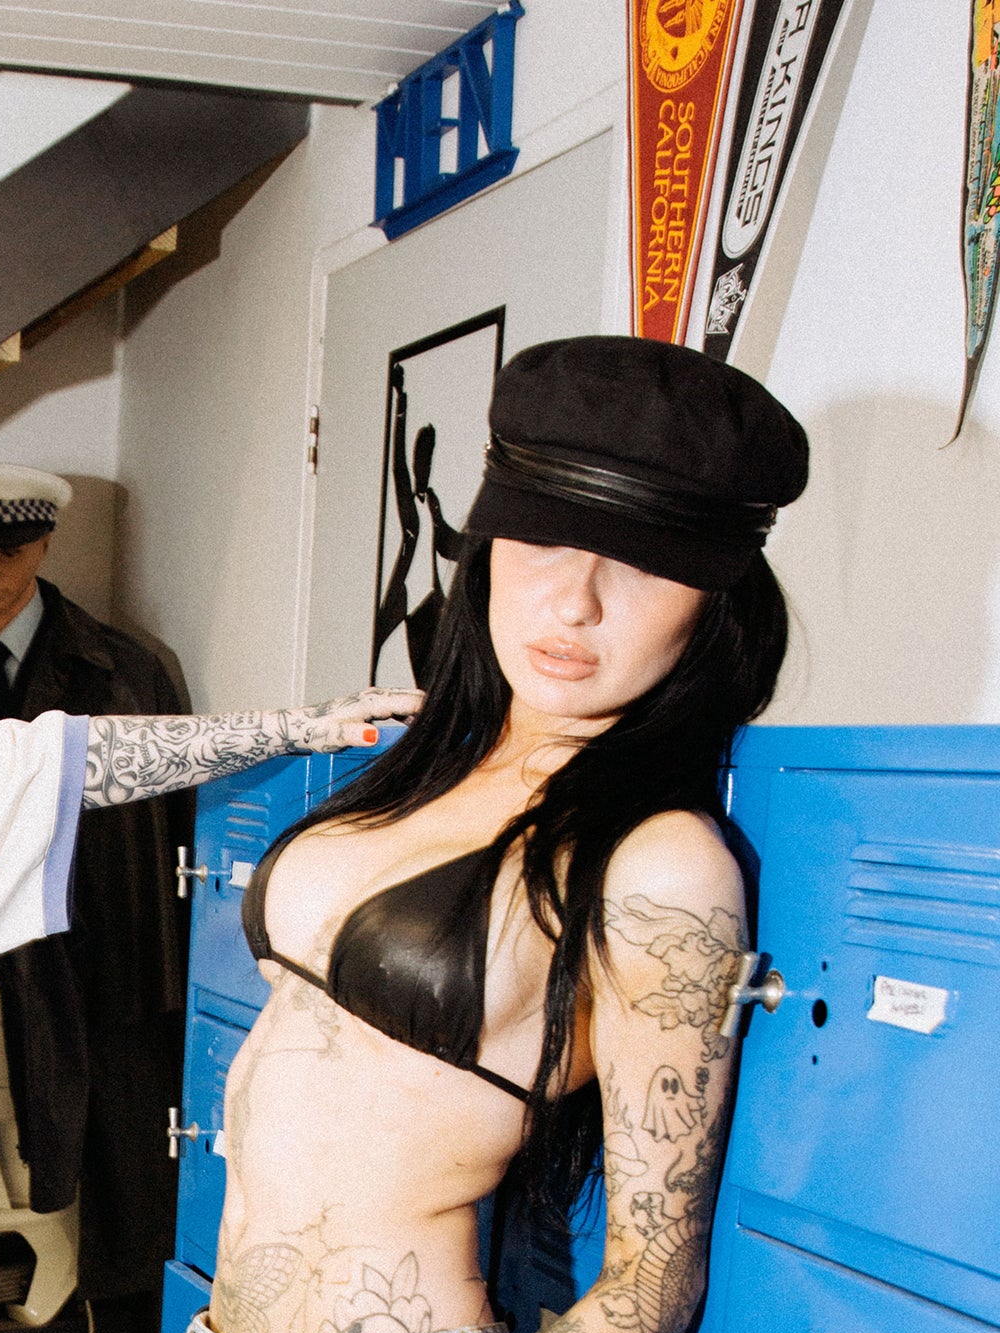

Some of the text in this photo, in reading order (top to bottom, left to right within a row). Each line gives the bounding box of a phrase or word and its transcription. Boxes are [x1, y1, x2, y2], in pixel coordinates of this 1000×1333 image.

[375, 15, 517, 222] MEN
[643, 99, 675, 312] CALIFORNIA
[663, 101, 695, 302] SOUTHERN
